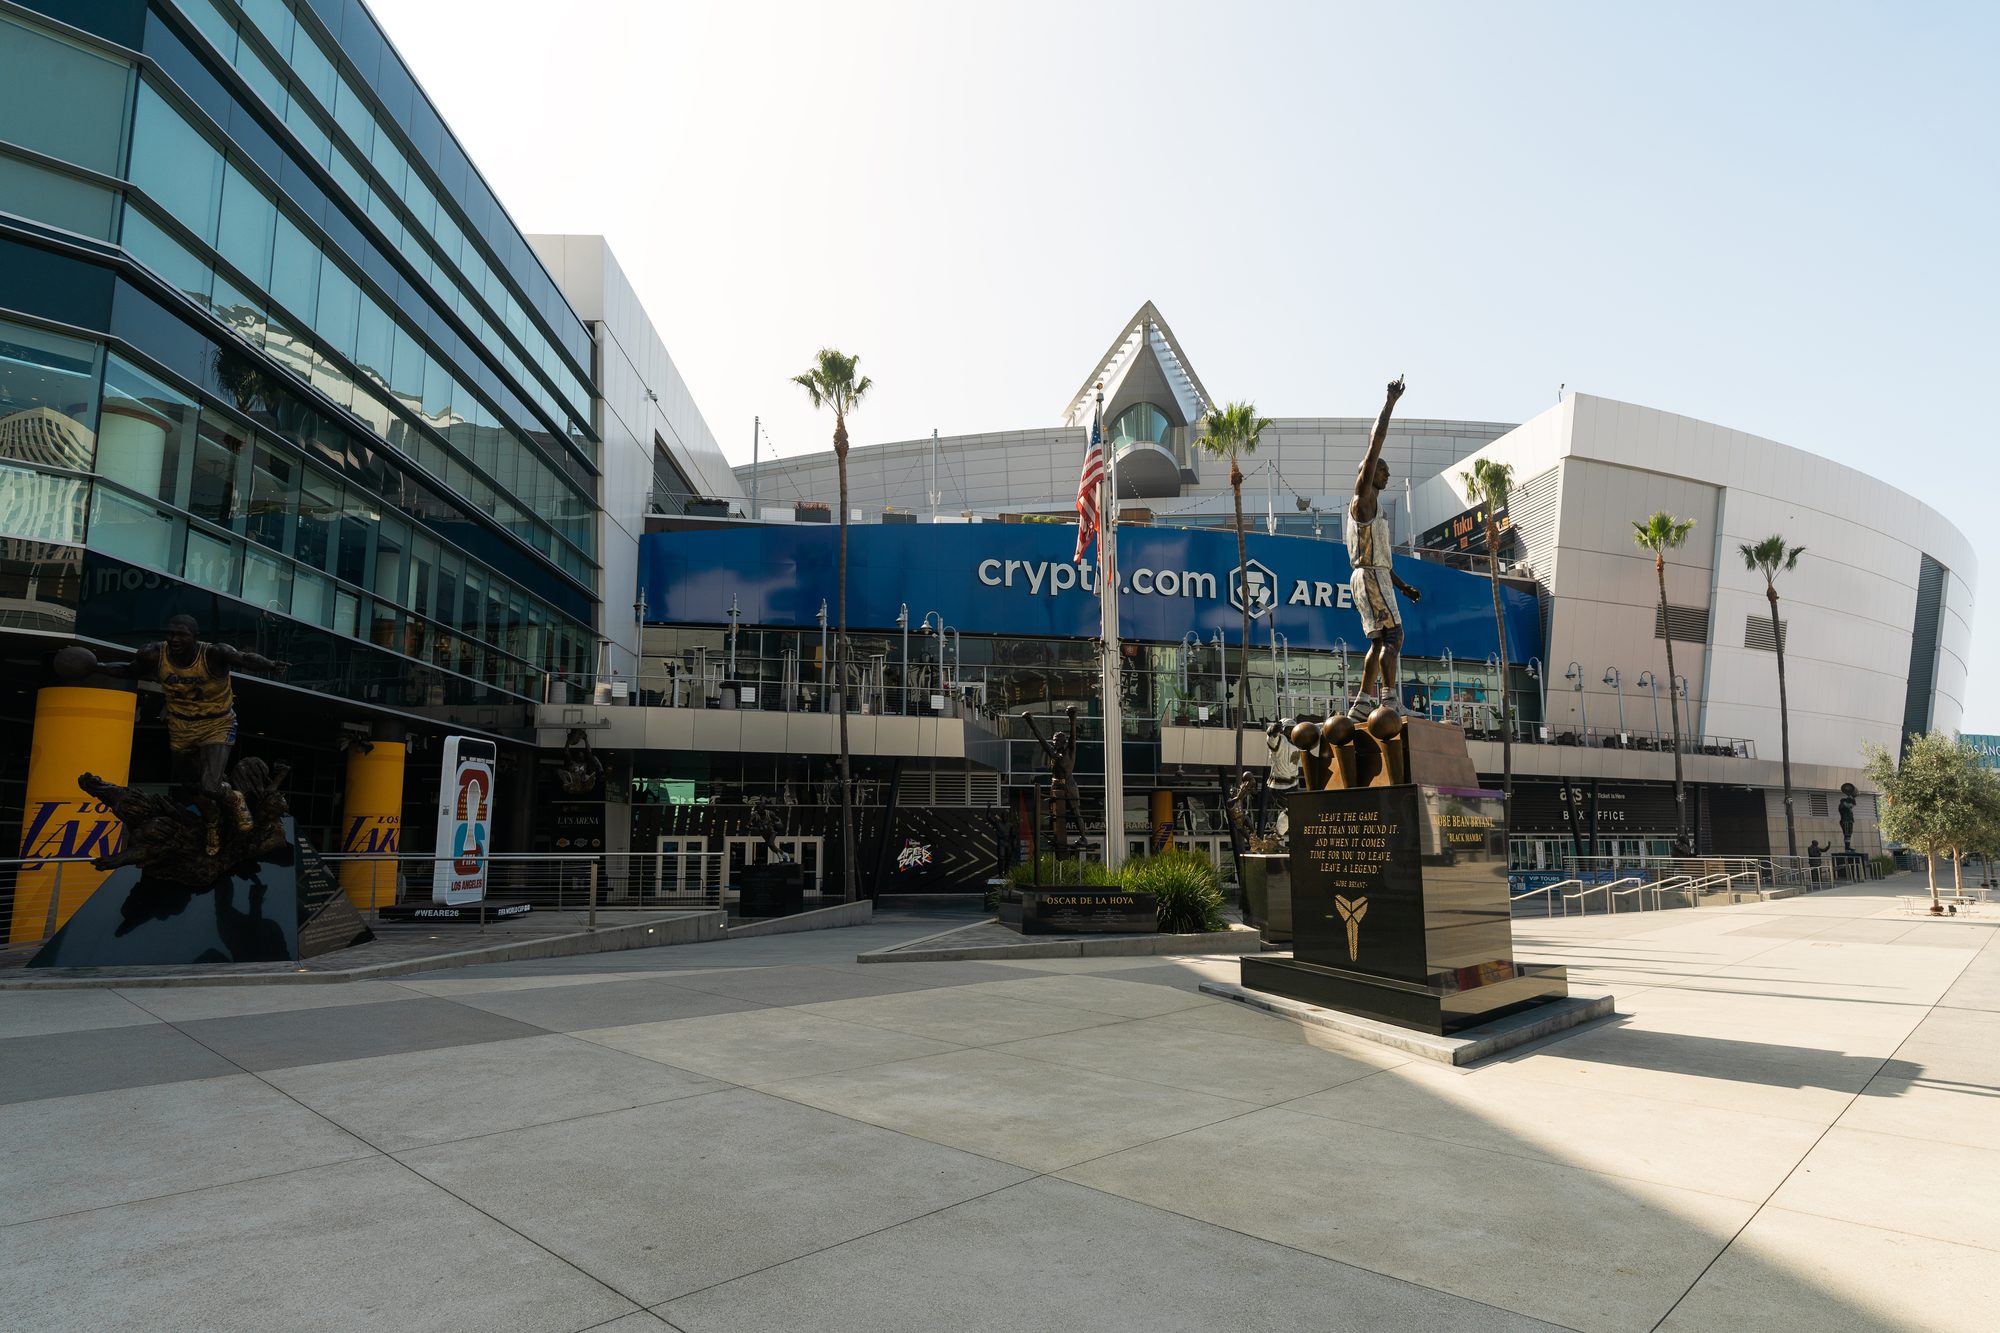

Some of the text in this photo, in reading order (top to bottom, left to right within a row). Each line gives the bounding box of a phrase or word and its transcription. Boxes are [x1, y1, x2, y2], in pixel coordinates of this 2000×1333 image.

[1453, 516, 1473, 538] fuku
[979, 558, 1352, 608] crypt.com ARE
[77, 802, 113, 813] LO
[377, 816, 400, 824] LOS
[574, 816, 598, 824] ARENA
[1343, 812, 1357, 822] THE
[1359, 811, 1378, 821] GAME
[1452, 816, 1469, 827] BEAN
[1563, 811, 1625, 821] BX FFICE
[1303, 824, 1400, 835] BETTER THAN YOU FOUND IT.
[20, 802, 122, 870] LAK
[343, 816, 399, 857] LAK
[1315, 838, 1386, 848] AND WHEN IT COMES
[1310, 850, 1325, 859] TIME
[1327, 850, 1340, 860] FOR
[1341, 851, 1354, 860] YOU
[1357, 851, 1366, 861] TO
[1320, 863, 1341, 872] LEAVE
[1343, 864, 1348, 873] A
[451, 879, 482, 892] LOS ANGELES
[1047, 896, 1134, 905] OSCAR DE LA HOYA
[414, 909, 460, 918] #WEARE26
